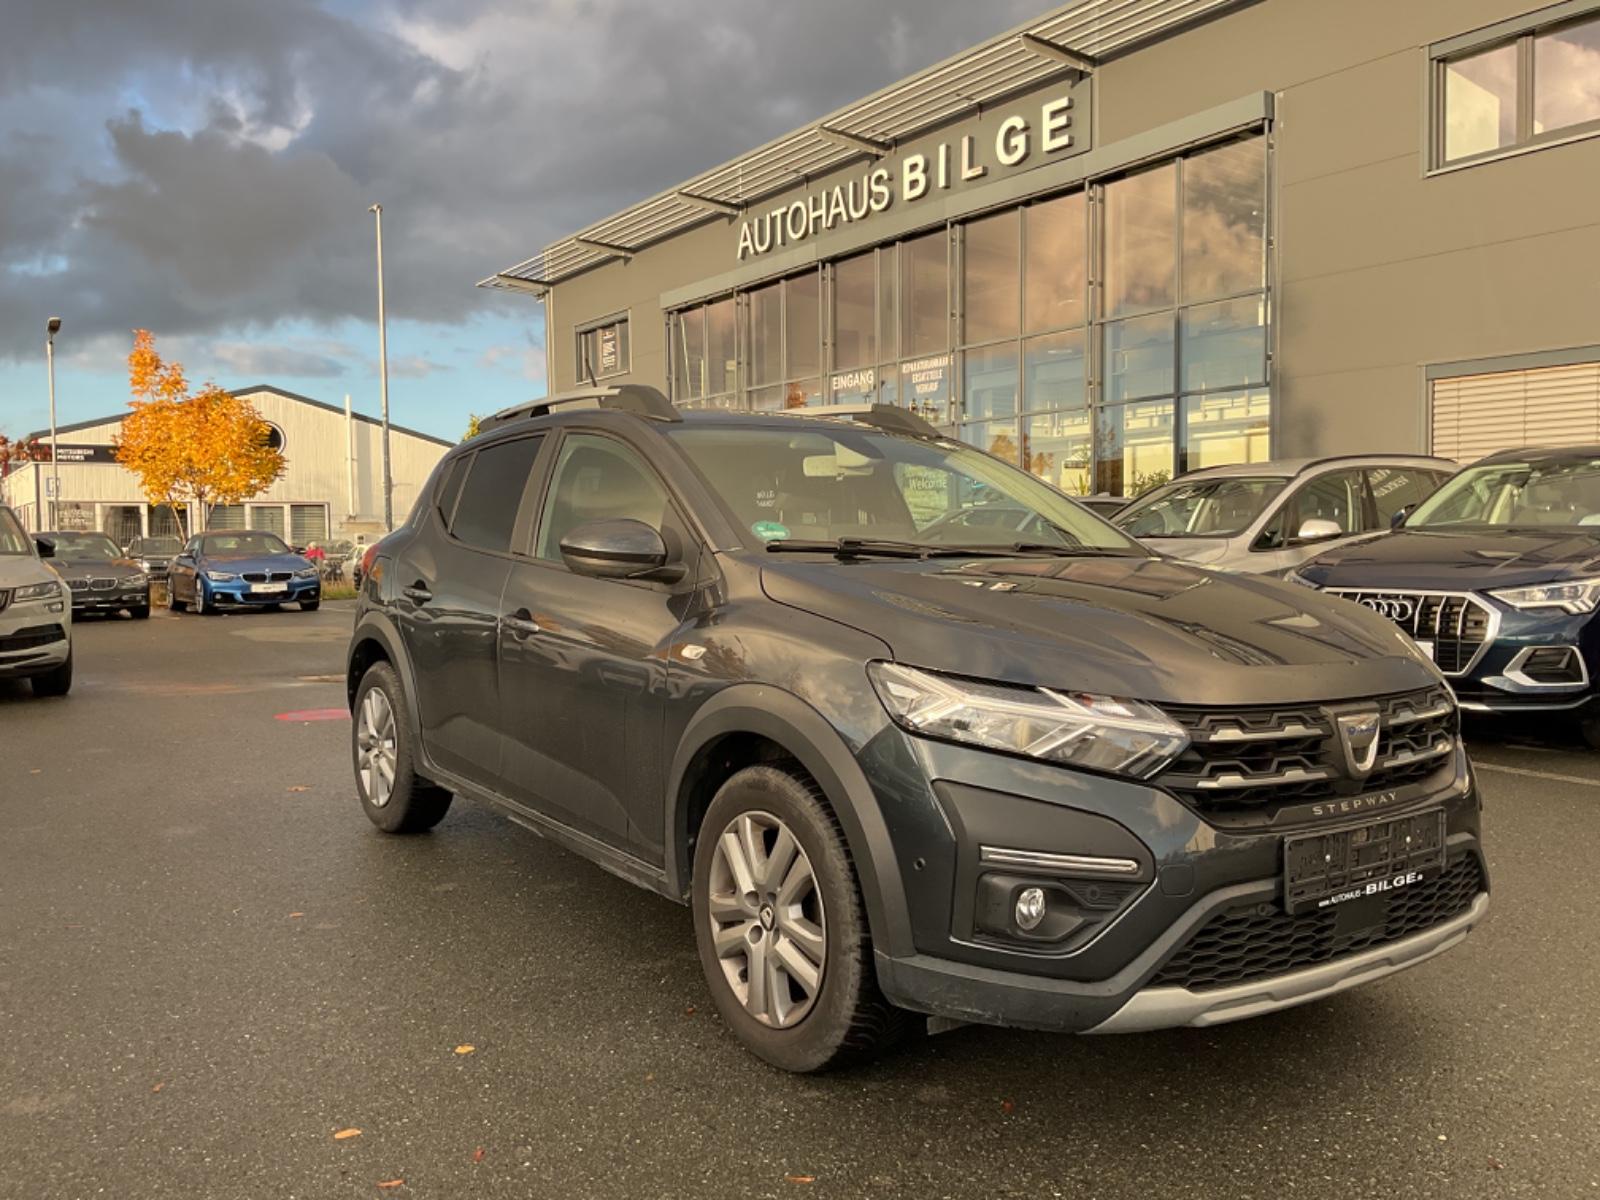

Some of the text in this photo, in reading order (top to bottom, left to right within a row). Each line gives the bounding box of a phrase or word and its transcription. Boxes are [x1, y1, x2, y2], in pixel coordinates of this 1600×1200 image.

[737, 96, 1076, 260] AUTOHAUS BILGE
[833, 370, 874, 390] EINGANG
[1312, 793, 1397, 815] STEPWAY
